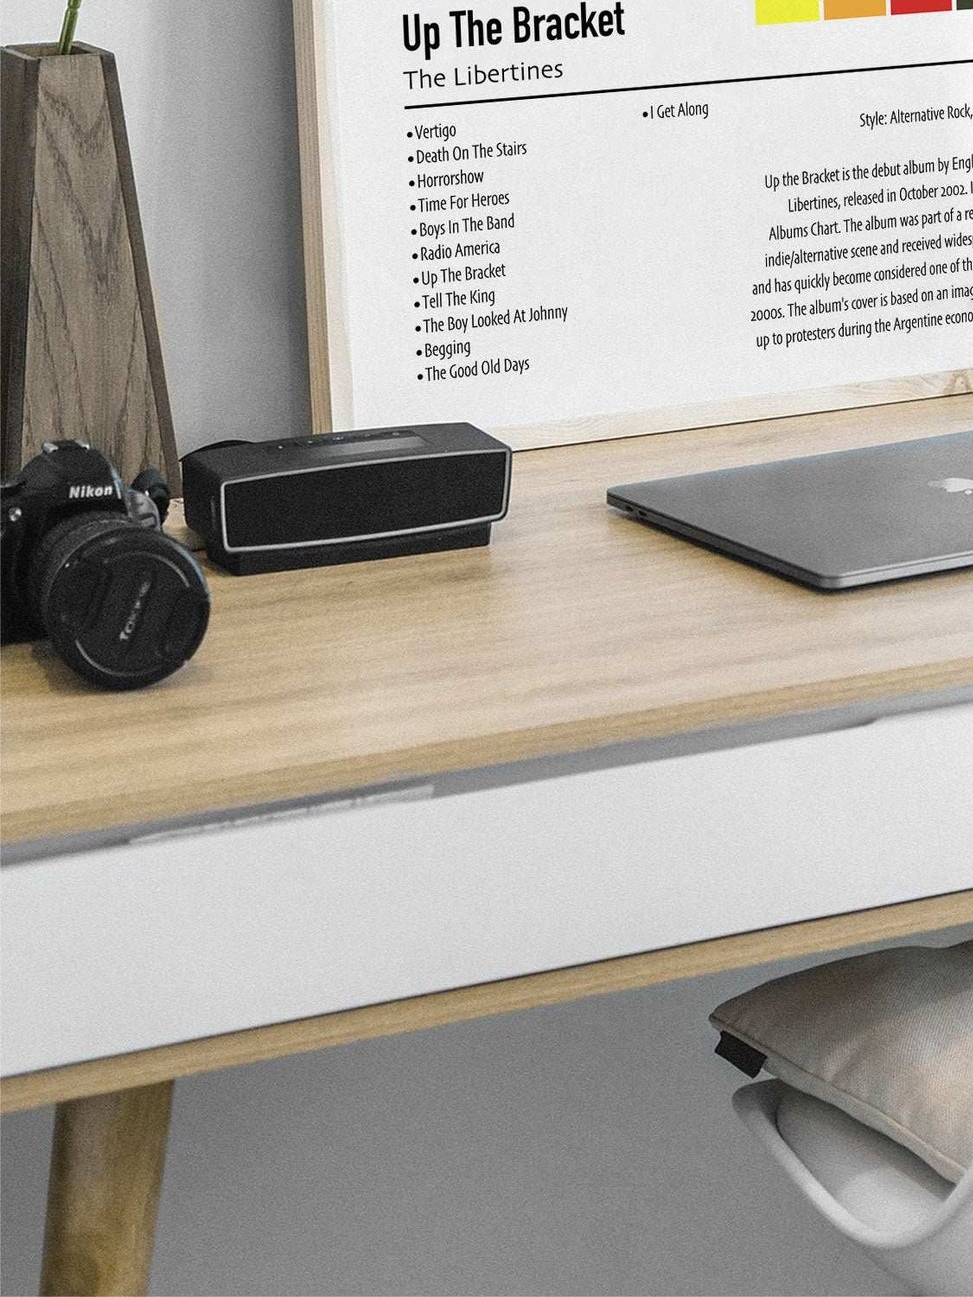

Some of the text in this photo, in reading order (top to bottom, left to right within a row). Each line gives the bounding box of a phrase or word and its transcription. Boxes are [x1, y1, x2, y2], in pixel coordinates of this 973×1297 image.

[402, 1, 625, 61] Up The Bracket
[403, 62, 563, 90] The Libertines
[657, 104, 676, 119] Get
[677, 101, 709, 119] Along
[860, 111, 887, 130] Style:
[890, 107, 945, 124] Alternative
[947, 103, 973, 119] Rock,
[414, 123, 456, 142] Vertigo
[416, 141, 527, 164] Death On The Stairs
[417, 169, 484, 188] Horrorshow
[765, 174, 780, 192] Up
[782, 172, 799, 187] the
[802, 168, 840, 185] Bracket
[842, 167, 850, 181] is
[852, 165, 869, 180] the
[871, 162, 901, 178] debut
[903, 160, 935, 175] album
[938, 157, 949, 175] by
[417, 193, 510, 212] Time For Heroes
[788, 195, 841, 213] Libertines,
[844, 188, 884, 207] released
[887, 189, 896, 202] in
[899, 184, 939, 201] October
[941, 185, 968, 197] 2002.
[420, 212, 515, 239] Boys In The Band
[769, 225, 808, 241] Albums
[810, 221, 841, 236] Chart.
[843, 218, 863, 232] The
[865, 215, 897, 231] album
[899, 215, 919, 227] was
[921, 211, 942, 229] part
[944, 207, 954, 223] of
[956, 210, 962, 221] a
[420, 240, 500, 261] Radio America
[765, 246, 848, 269] indie/alternative
[850, 245, 878, 259] scene
[880, 239, 899, 255] and
[902, 234, 942, 252] received
[421, 263, 506, 289] Up The Bracket
[752, 279, 771, 295] and
[774, 278, 792, 292] has
[794, 273, 830, 294] quickly
[833, 271, 871, 286] become
[874, 261, 927, 281] considered
[929, 263, 948, 275] one
[950, 258, 960, 273] of
[422, 289, 495, 309] Tell The King
[751, 308, 785, 322] 2000s.
[787, 302, 807, 317] The
[809, 297, 849, 315] album's
[851, 297, 878, 310] cover
[880, 293, 888, 307] is
[891, 288, 918, 305] based
[921, 290, 934, 302] on
[936, 289, 948, 300] an
[423, 305, 568, 334] The Boy Looked At Johnny
[756, 335, 770, 350] up
[772, 333, 783, 345] to
[786, 327, 836, 348] protesters
[838, 322, 872, 338] during
[874, 318, 891, 333] the
[893, 313, 943, 334] Argentine
[425, 340, 471, 360] Begging
[425, 358, 530, 381] The Good Old Days
[69, 485, 113, 499] Nikon
